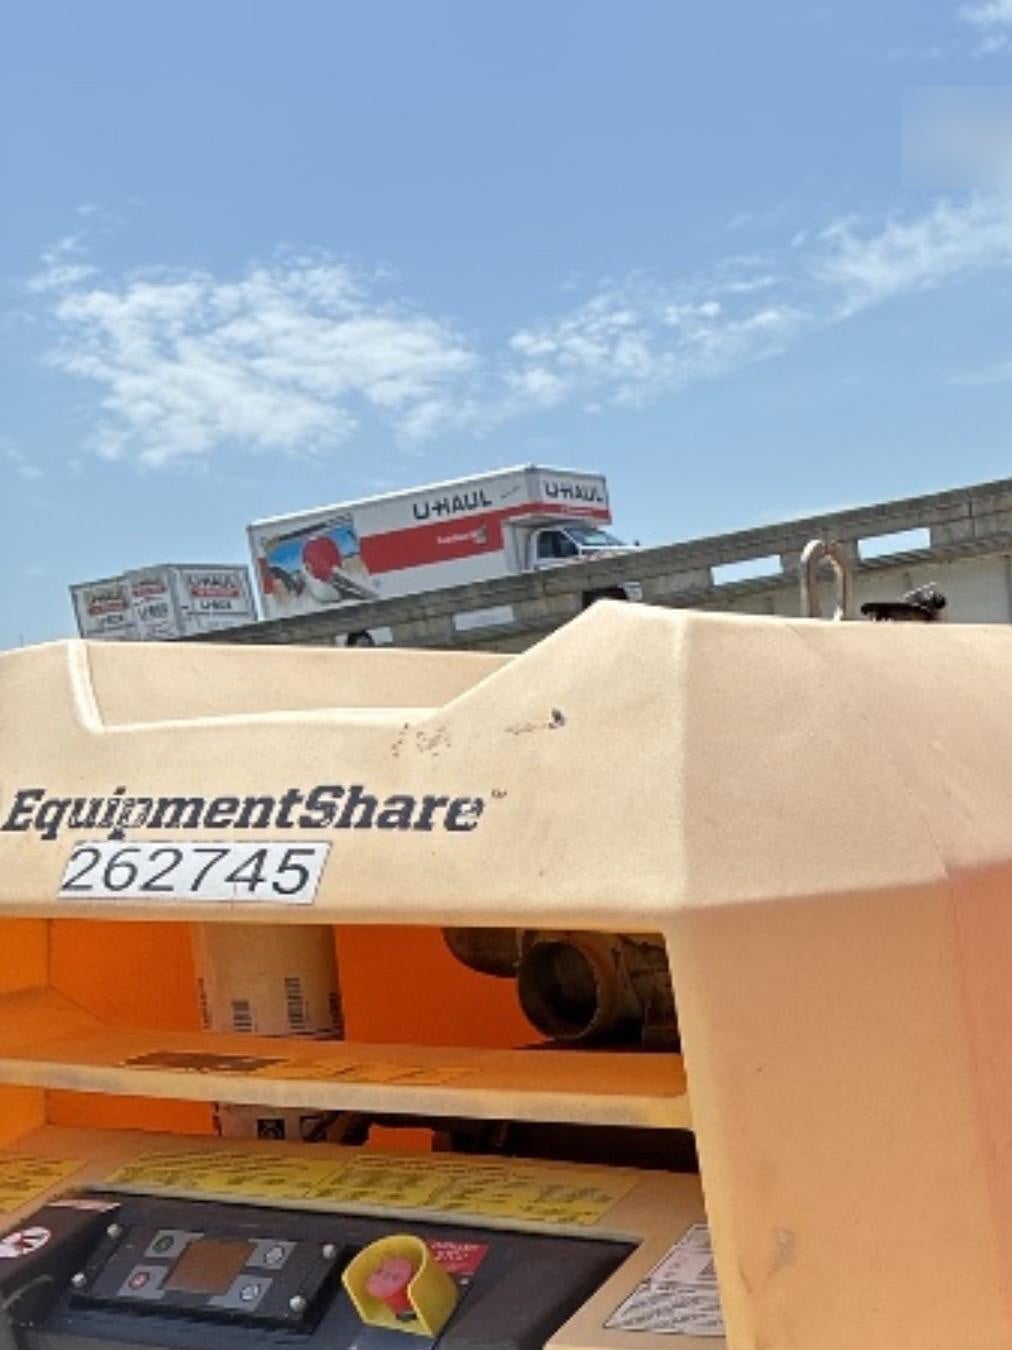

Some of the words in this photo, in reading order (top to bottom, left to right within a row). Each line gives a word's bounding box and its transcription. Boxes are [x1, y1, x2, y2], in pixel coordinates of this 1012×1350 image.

[413, 488, 493, 520] U-HAUL
[1, 785, 486, 840] EquipmentShare
[62, 847, 316, 896] 262745
